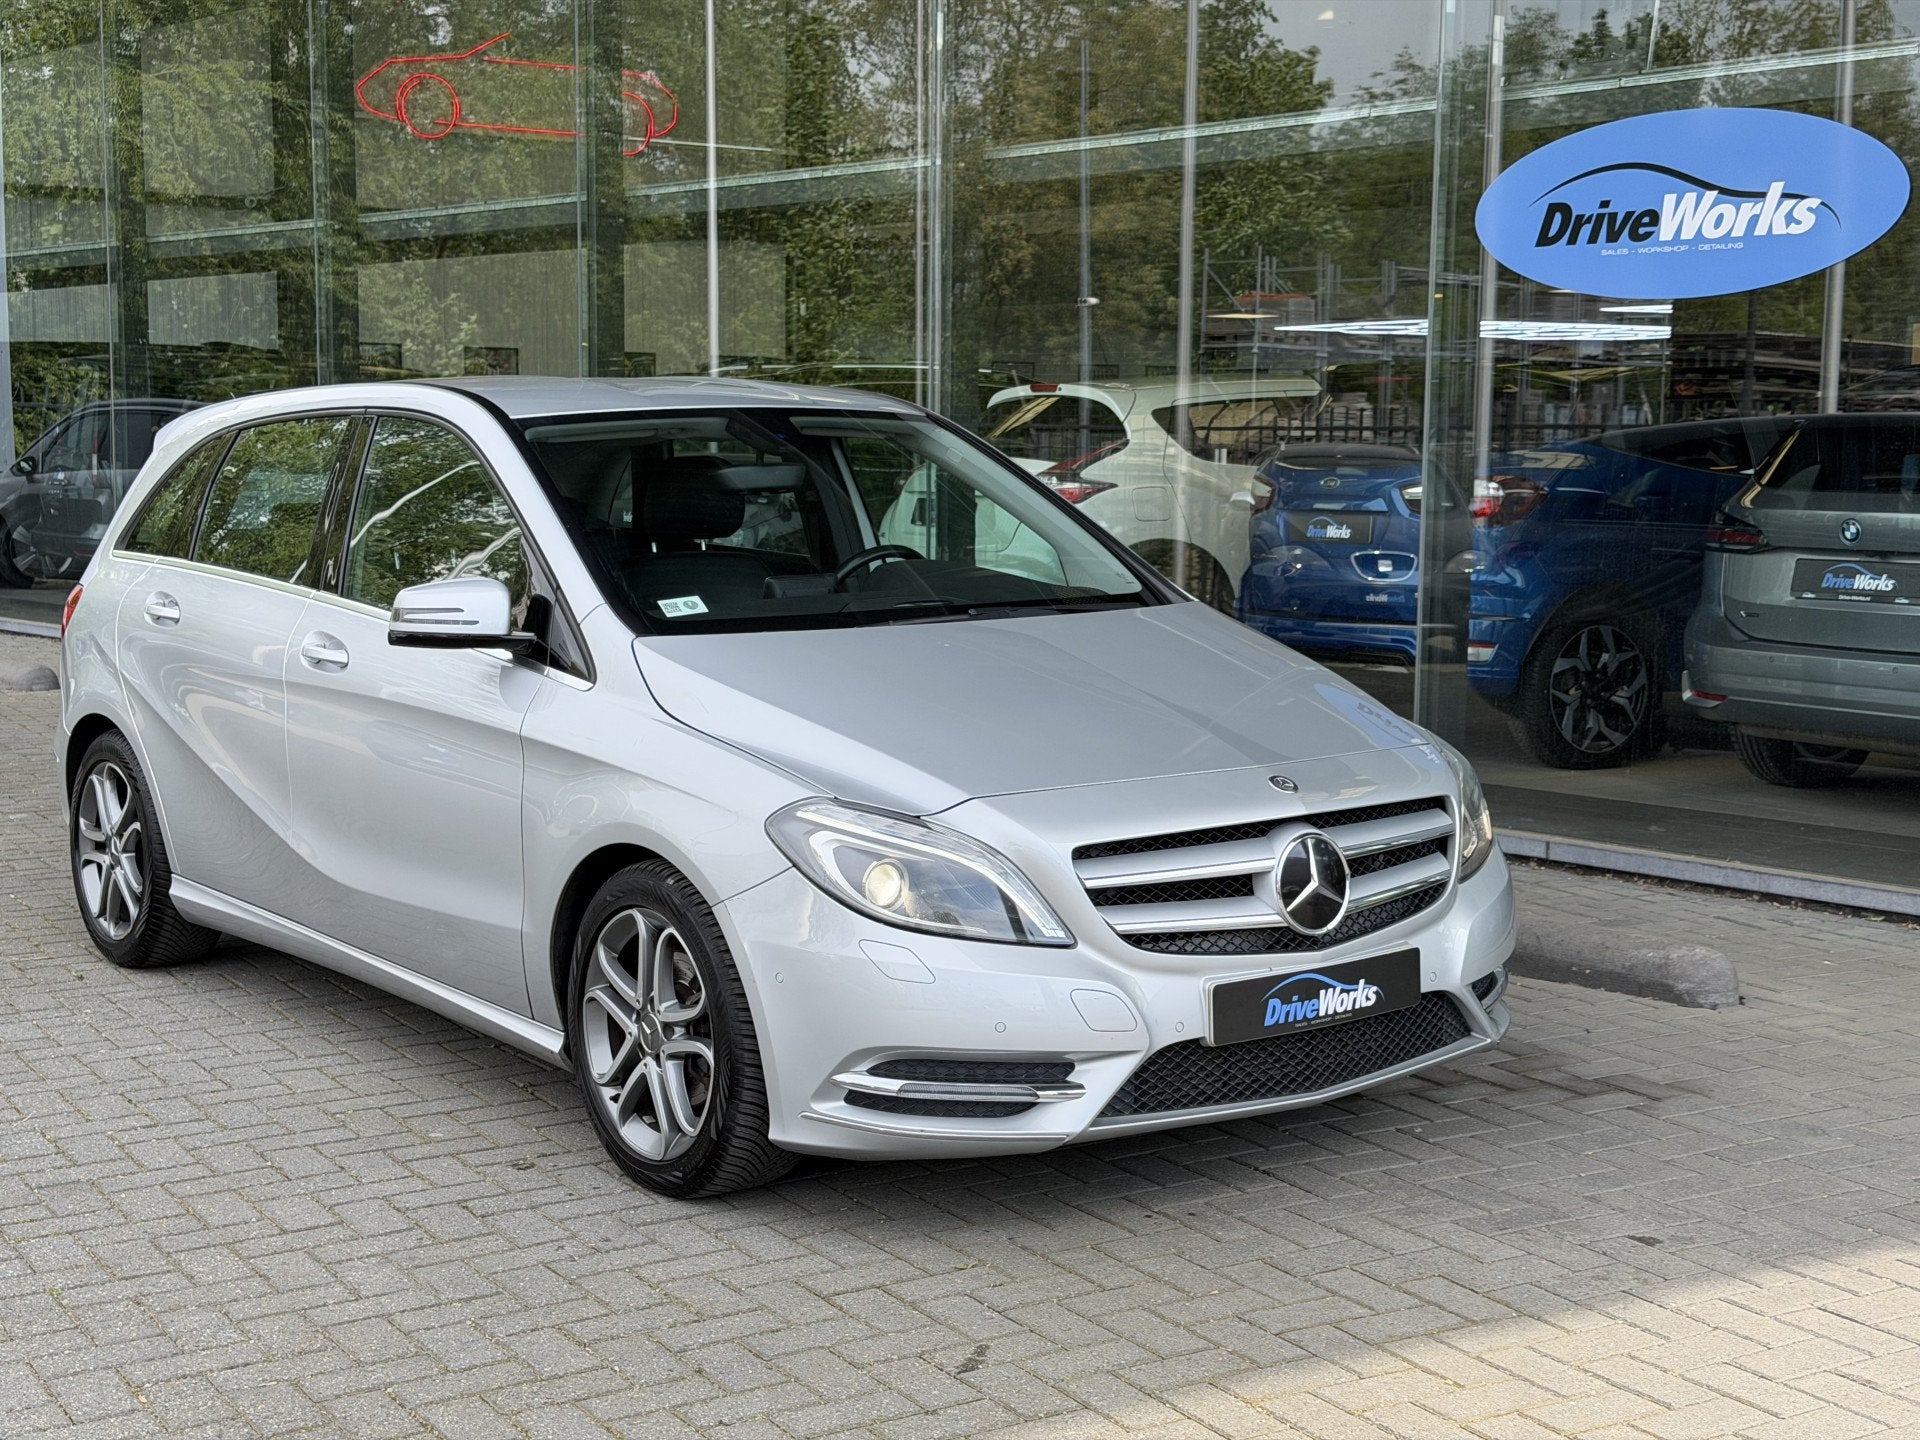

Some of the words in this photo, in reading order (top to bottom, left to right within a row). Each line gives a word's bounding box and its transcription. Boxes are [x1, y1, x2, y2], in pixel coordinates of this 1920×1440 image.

[1534, 181, 1822, 248] DriveWorks
[1601, 248, 1628, 256] SALES
[1637, 245, 1689, 254] WORKSHOP
[1698, 242, 1744, 251] DETAILING
[1306, 524, 1352, 539] DriveWorks
[1821, 572, 1896, 591] DriveWorks
[1263, 978, 1378, 1027] DriveWorks
